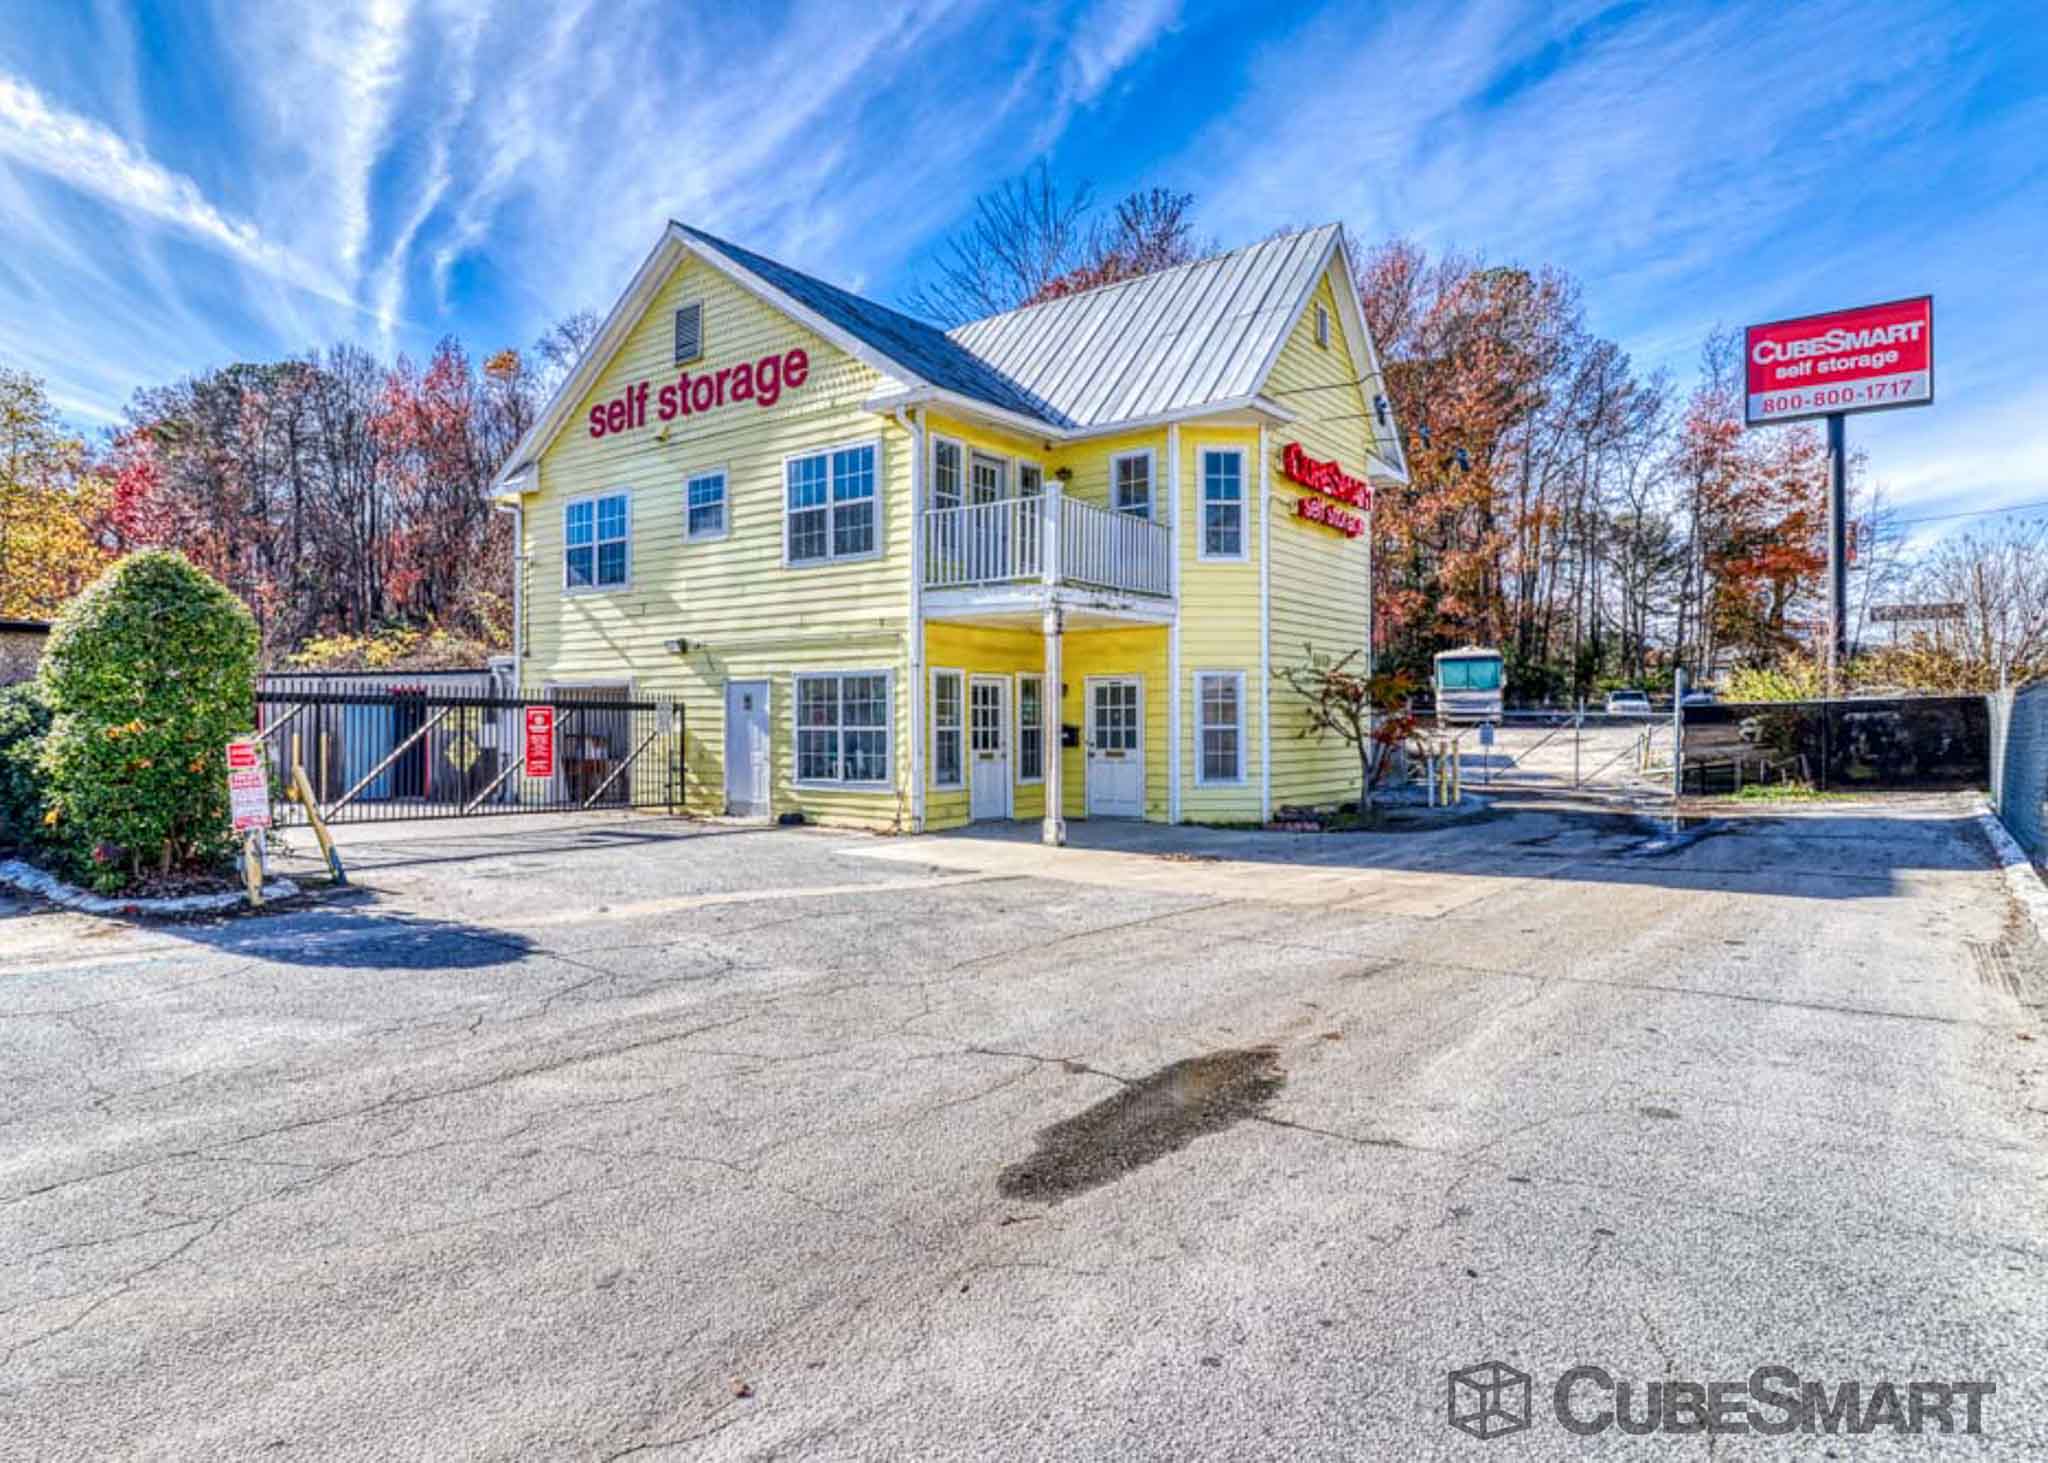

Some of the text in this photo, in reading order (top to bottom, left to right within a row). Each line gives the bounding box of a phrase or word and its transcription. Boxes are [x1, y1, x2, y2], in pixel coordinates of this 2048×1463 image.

[1753, 320, 1925, 365] CUBESMART
[1775, 349, 1899, 379] self storage
[589, 347, 809, 438] self storage
